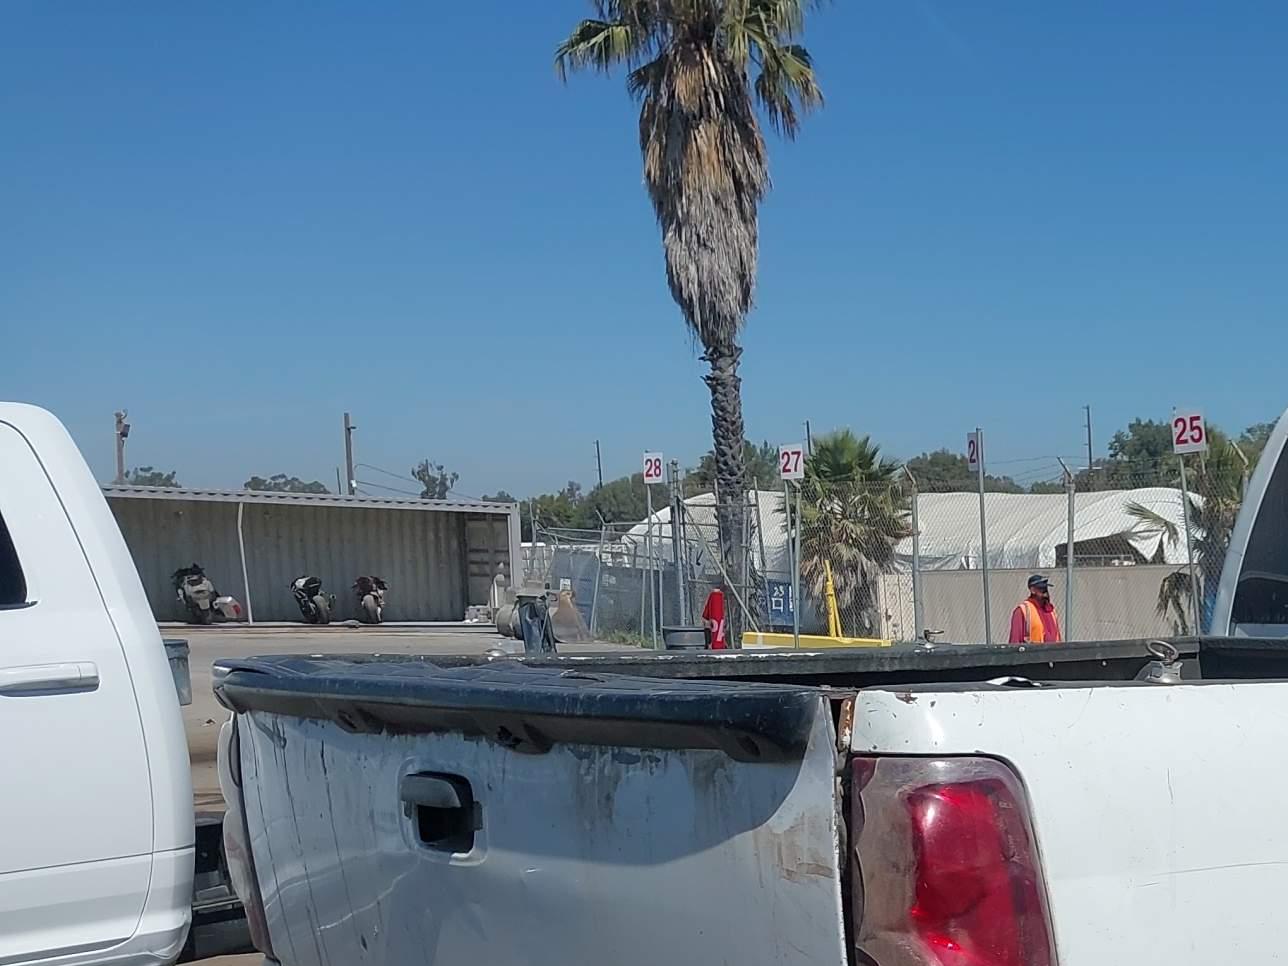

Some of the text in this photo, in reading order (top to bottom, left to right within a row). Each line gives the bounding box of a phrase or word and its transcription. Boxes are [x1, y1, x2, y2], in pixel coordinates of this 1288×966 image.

[1174, 415, 1204, 445] 25
[644, 457, 662, 478] 28
[780, 450, 802, 473] 27
